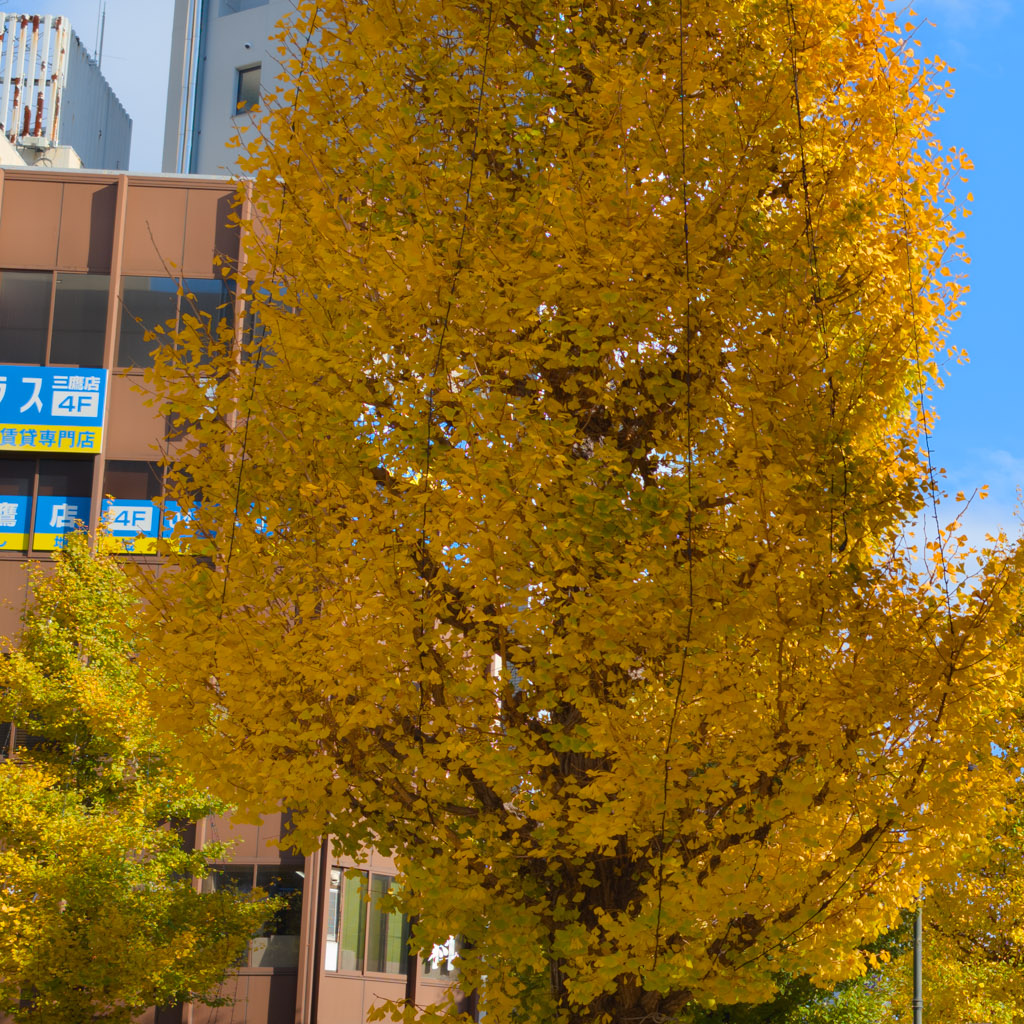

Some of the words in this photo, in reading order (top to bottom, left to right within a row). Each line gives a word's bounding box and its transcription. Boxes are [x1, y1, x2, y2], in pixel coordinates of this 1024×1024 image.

[52, 375, 101, 391] 三鷹店
[58, 395, 92, 413] 4F
[0, 427, 96, 449] 賃貸専門店
[114, 510, 147, 527] 4F
